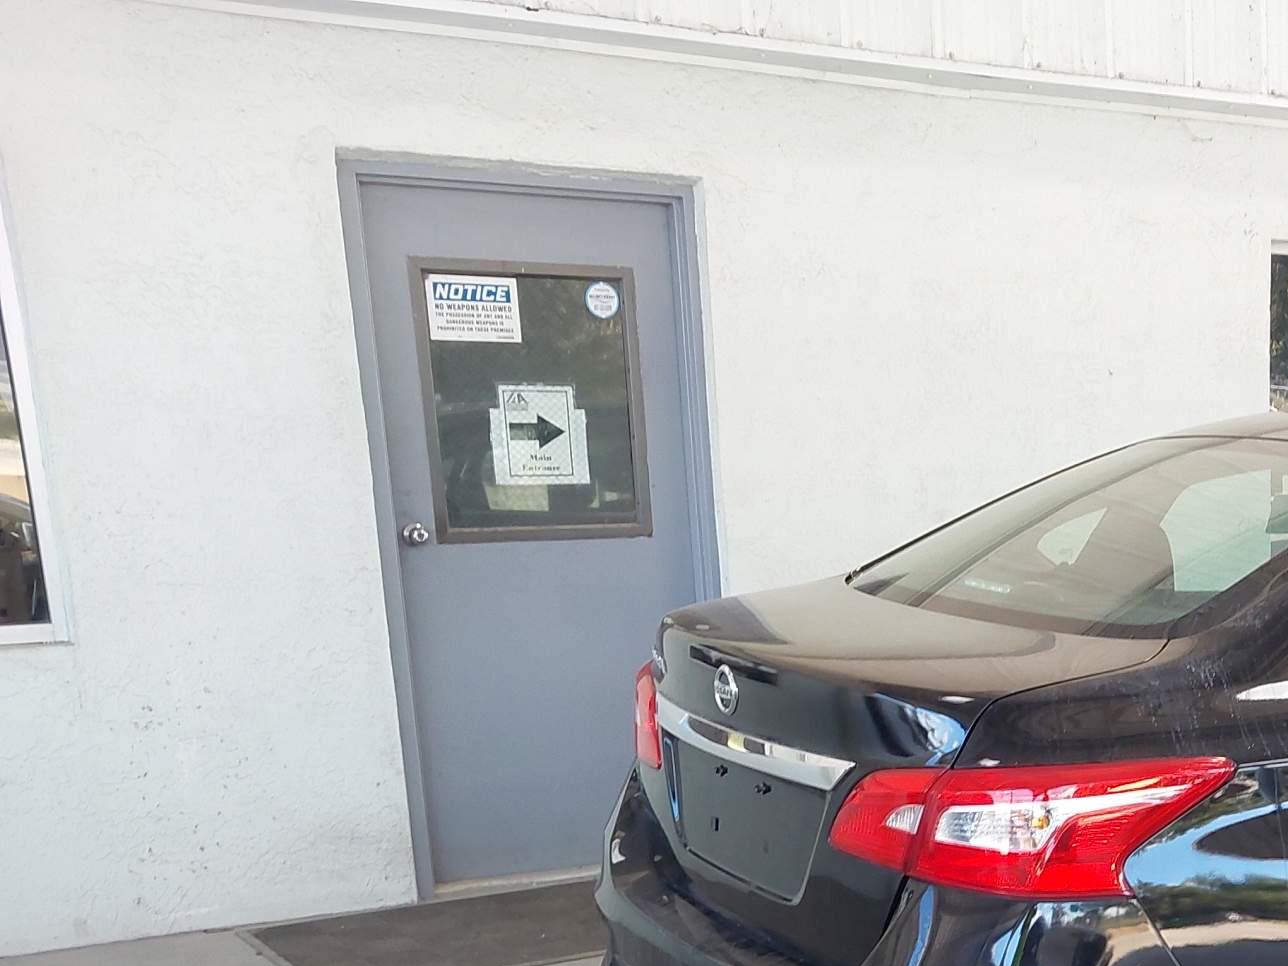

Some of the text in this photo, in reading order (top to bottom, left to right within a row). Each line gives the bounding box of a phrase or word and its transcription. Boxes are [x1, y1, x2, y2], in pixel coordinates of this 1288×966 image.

[435, 283, 509, 302] NOTICE
[447, 304, 480, 312] WEAPONS
[481, 305, 512, 313] ALLOWED
